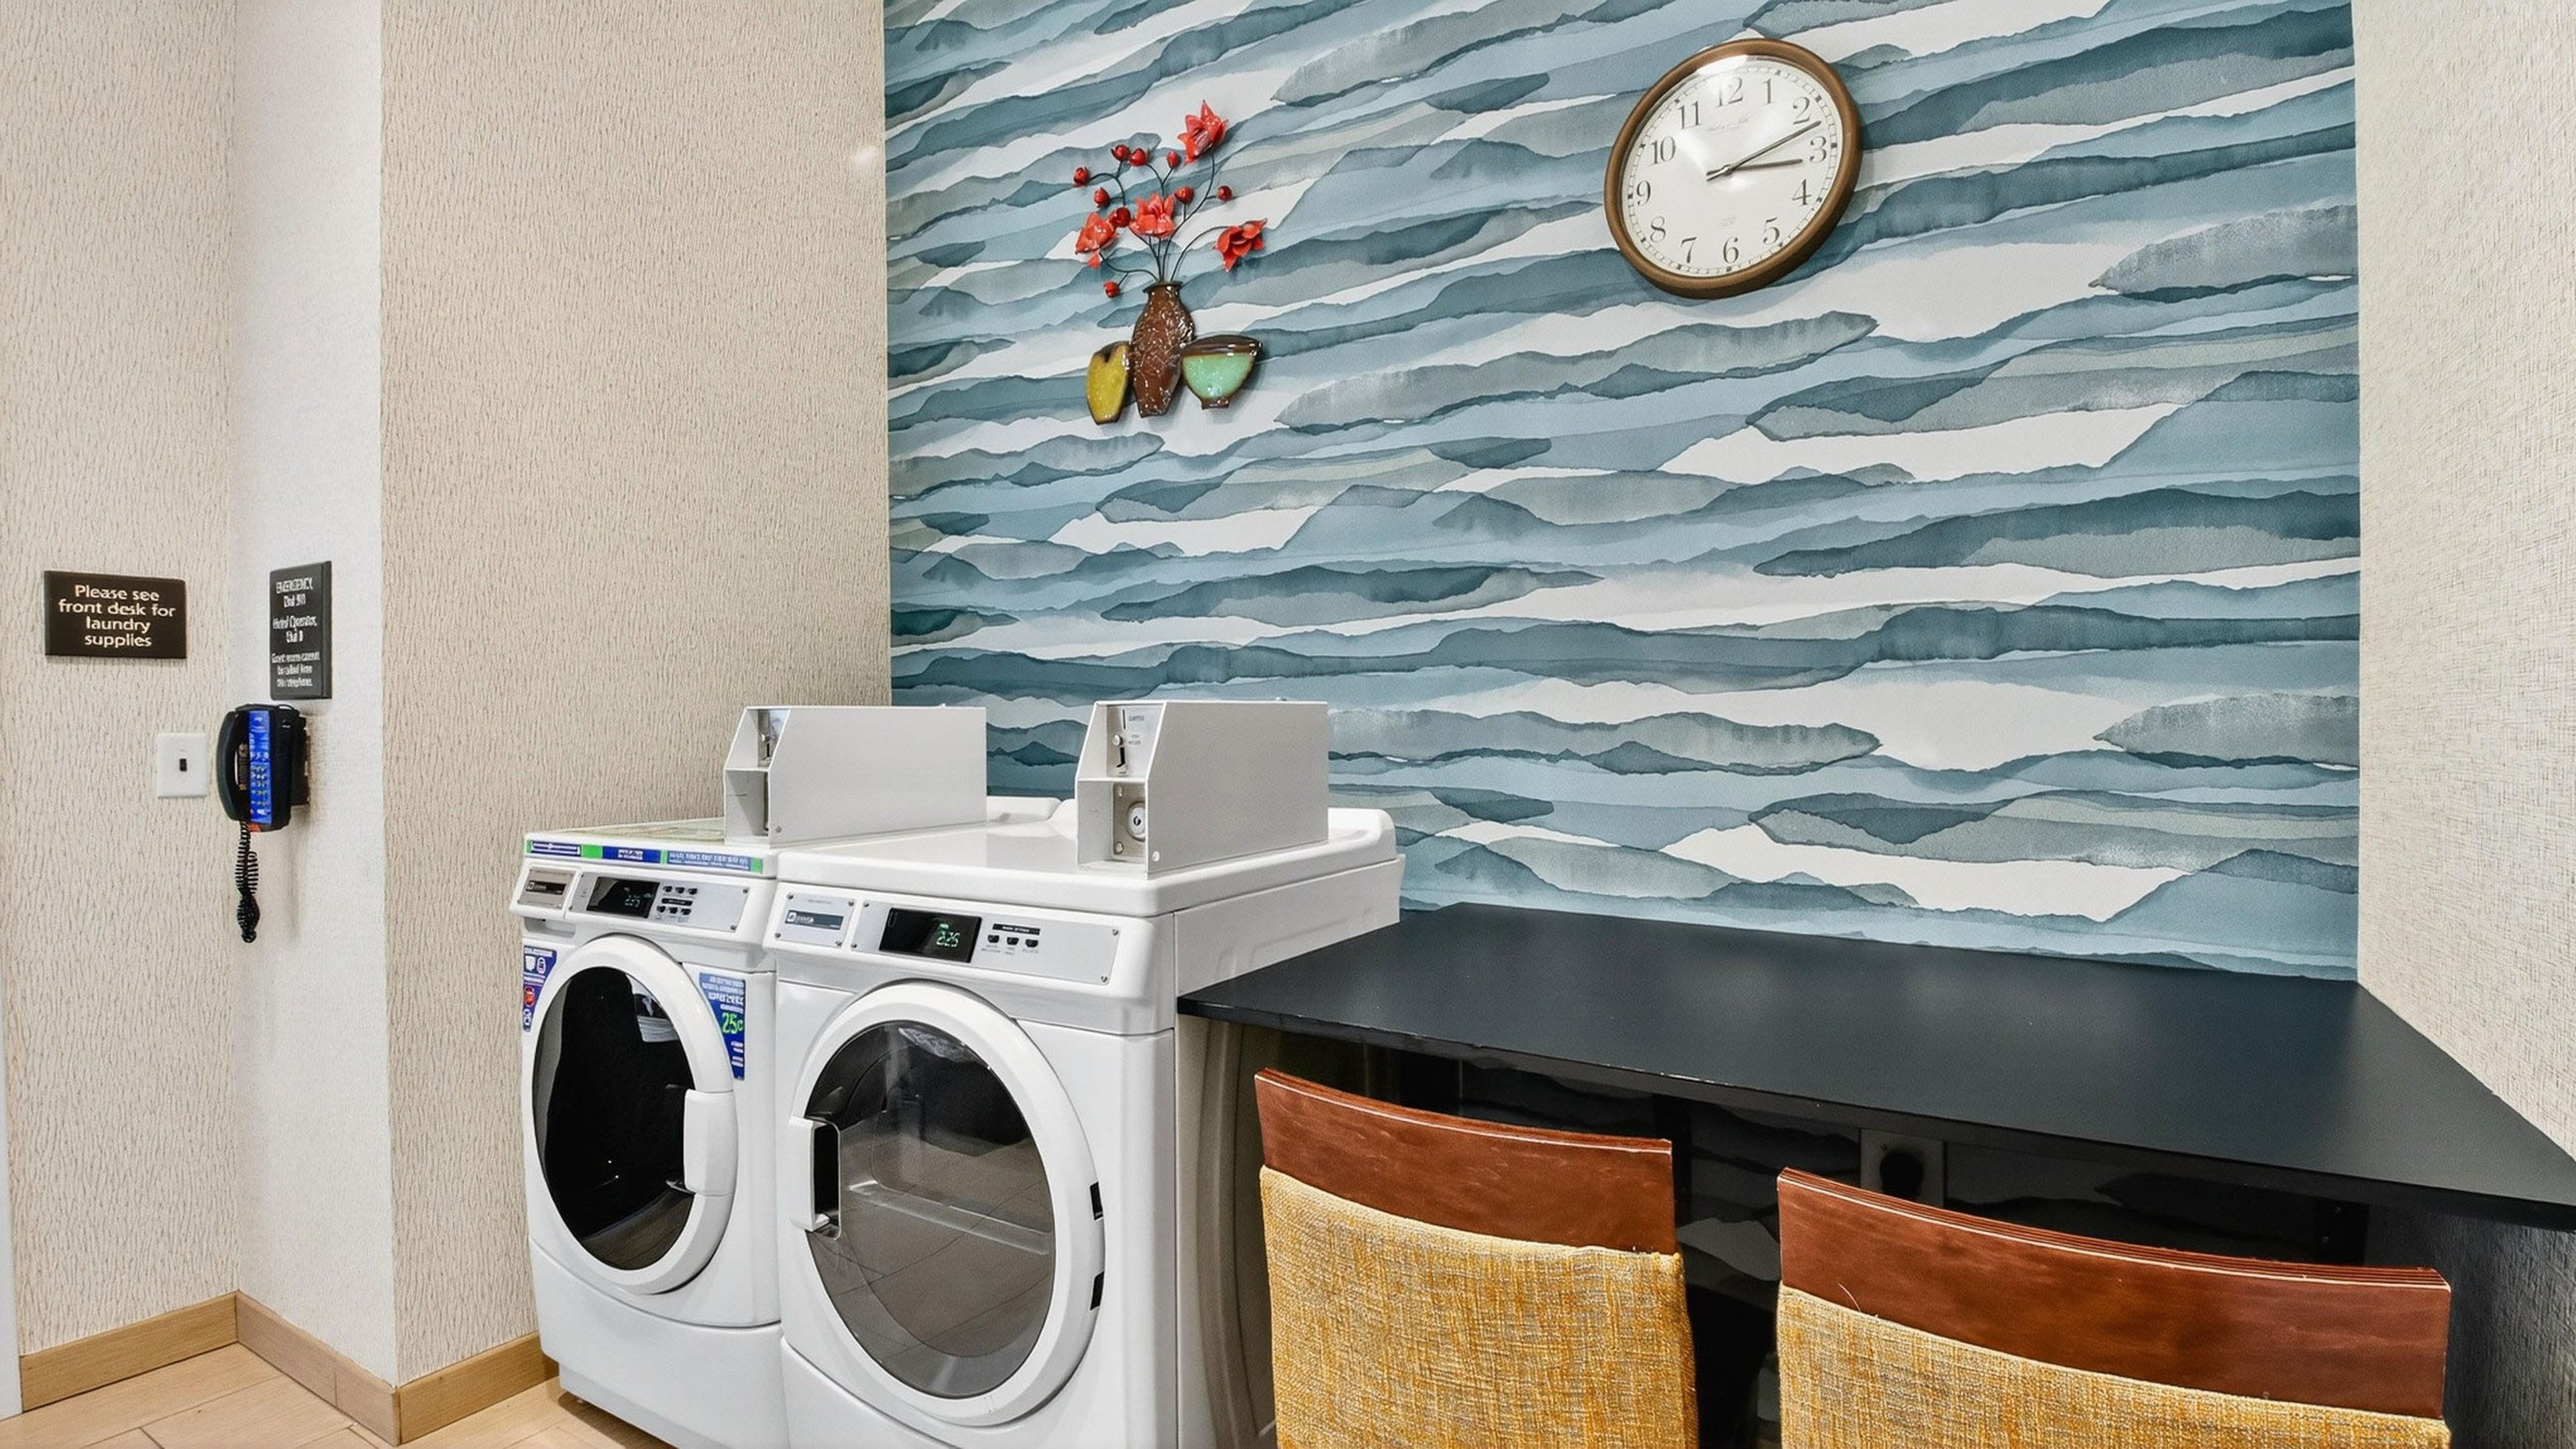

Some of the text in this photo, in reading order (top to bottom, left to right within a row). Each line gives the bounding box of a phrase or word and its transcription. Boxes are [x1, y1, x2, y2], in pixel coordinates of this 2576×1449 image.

[1717, 77, 1743, 108] 12
[1763, 77, 1772, 105] 1
[1678, 101, 1702, 129] 11
[1792, 96, 1811, 125] 2
[1651, 136, 1676, 164] 10
[1809, 136, 1827, 164] 3
[1636, 180, 1652, 205] 9
[1792, 178, 1812, 206] 4
[1650, 215, 1667, 243] 8
[1763, 217, 1780, 245] 5
[1680, 237, 1697, 264] 7
[1722, 236, 1739, 264] 6
[74, 584, 160, 601] Please see
[58, 598, 176, 617] front desk for
[86, 616, 151, 634] laundry
[85, 633, 152, 648] supplies
